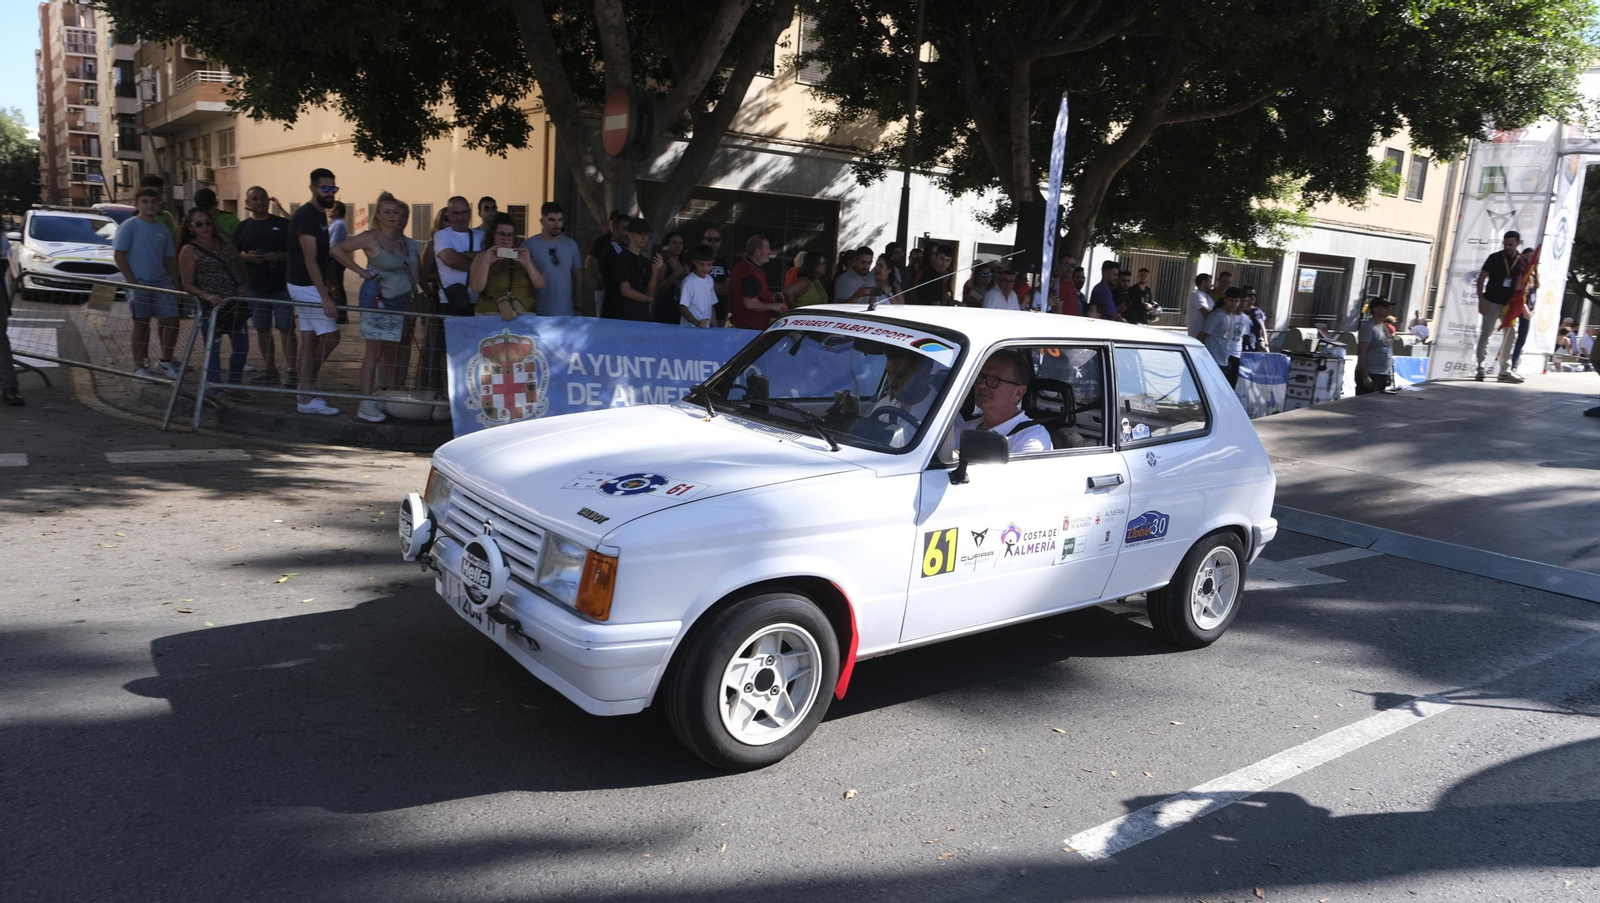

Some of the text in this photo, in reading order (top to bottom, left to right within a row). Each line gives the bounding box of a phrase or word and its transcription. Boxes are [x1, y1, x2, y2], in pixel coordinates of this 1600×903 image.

[789, 319, 914, 342] PEUGEOT TALBOT SPORT
[567, 382, 602, 406] DE
[665, 483, 695, 496] 61
[1023, 529, 1057, 541] COSTA DE
[1127, 526, 1151, 539] Doble
[1151, 517, 1167, 535] 30
[922, 528, 958, 577] 61
[961, 551, 994, 562] CUPRA
[1014, 538, 1056, 556] ALMERÍA
[462, 560, 489, 587] Hella
